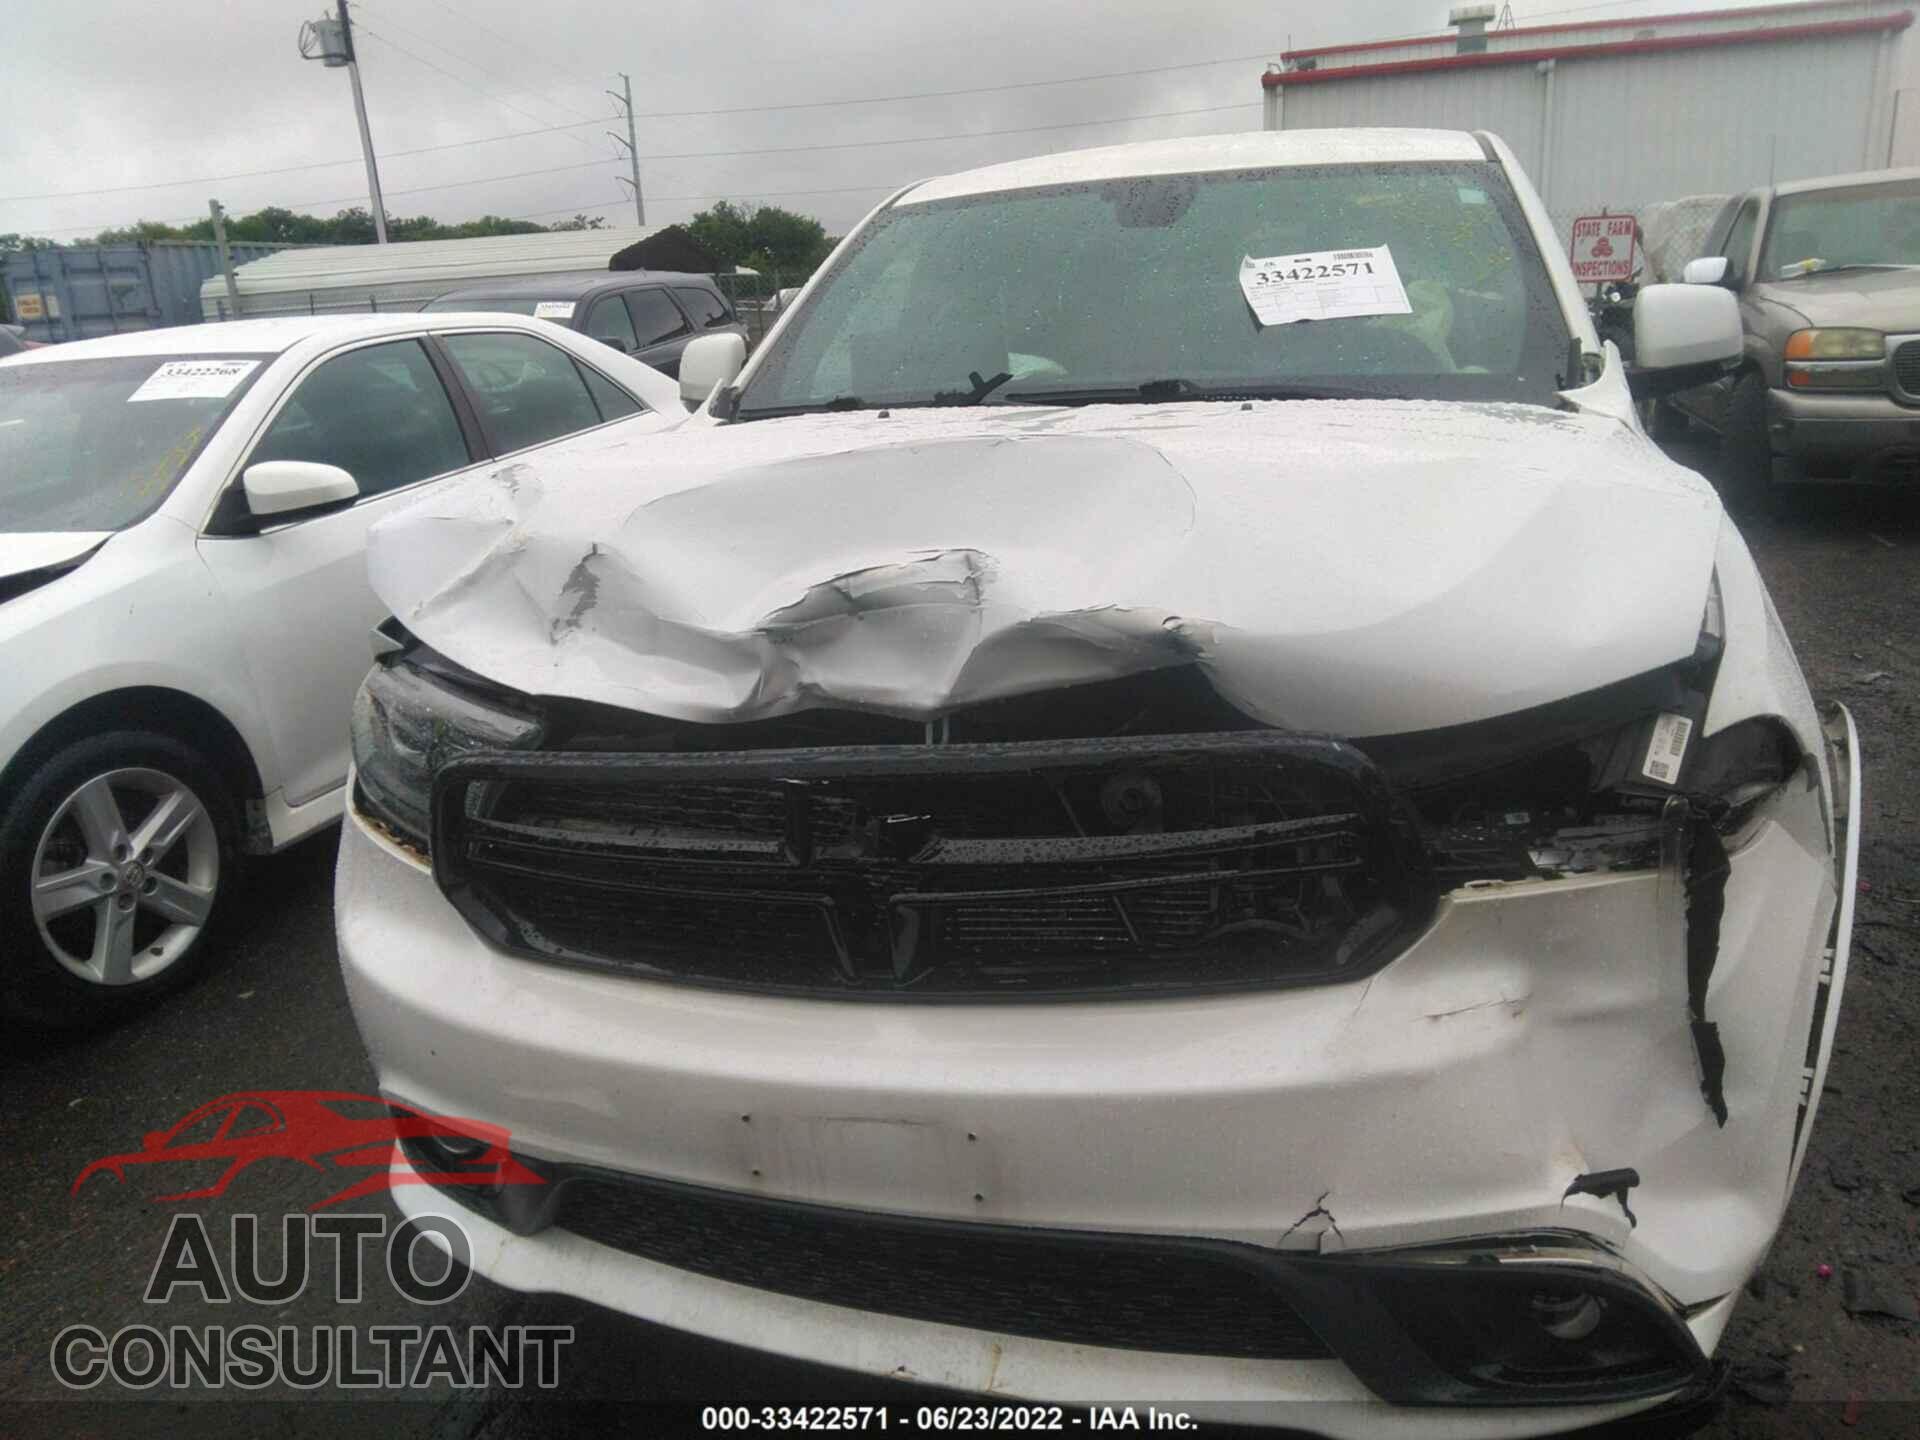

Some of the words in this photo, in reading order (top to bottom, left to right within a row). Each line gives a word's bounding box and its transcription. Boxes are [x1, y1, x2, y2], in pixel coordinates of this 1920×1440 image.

[1576, 222, 1601, 237] STATE
[1607, 221, 1632, 235] FARM
[1256, 262, 1374, 286] 33422571
